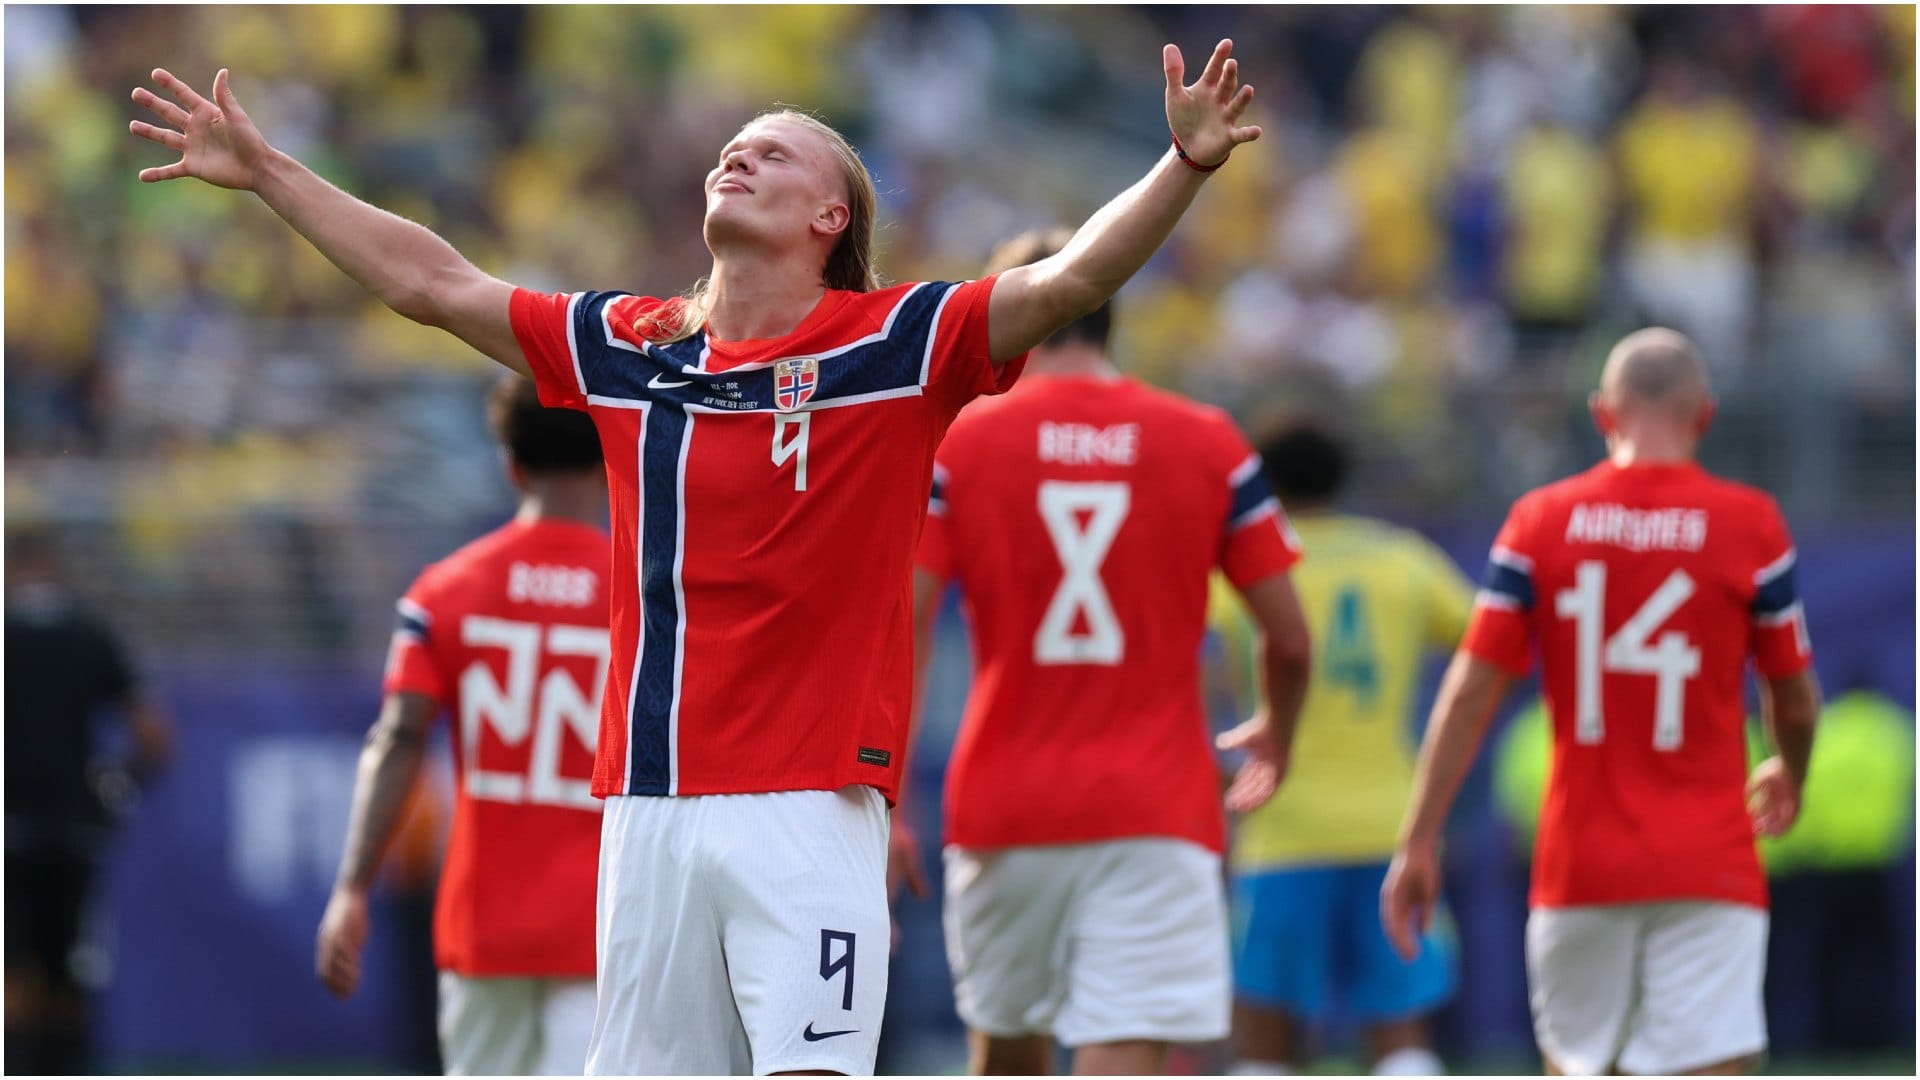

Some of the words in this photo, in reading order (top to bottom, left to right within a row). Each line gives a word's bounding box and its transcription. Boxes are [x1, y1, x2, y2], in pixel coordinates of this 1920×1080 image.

[771, 412, 811, 492] 9
[1034, 480, 1131, 665] 8
[1323, 583, 1380, 708] 4
[460, 615, 613, 811] 22
[1554, 559, 1702, 751] 14
[819, 929, 857, 1011] 9
